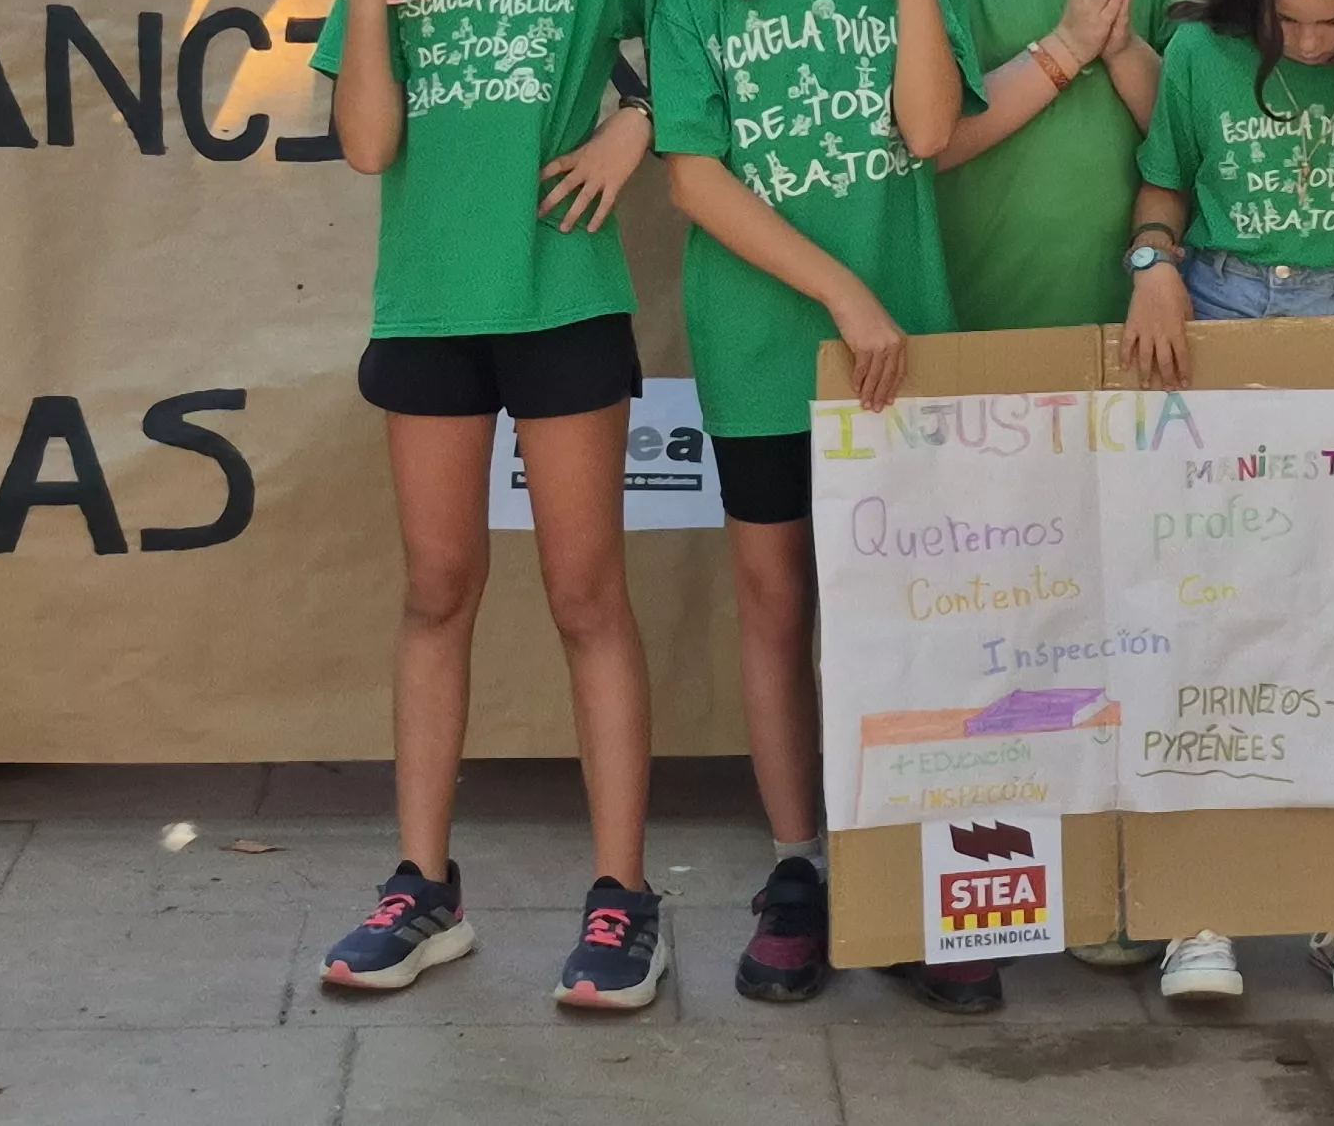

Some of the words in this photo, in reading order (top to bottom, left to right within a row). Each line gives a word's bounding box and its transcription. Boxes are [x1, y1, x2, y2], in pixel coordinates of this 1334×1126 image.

[417, 42, 448, 68] DE
[459, 35, 548, 62] TOD@S
[471, 77, 553, 103] TOD@S
[734, 105, 785, 149] DE
[1247, 169, 1280, 193] DE
[1236, 209, 1302, 235] PARA
[816, 390, 1205, 460] INJUSTICIA
[851, 495, 1065, 558] Queremos
[1152, 493, 1294, 562] profes
[907, 565, 1081, 622] Contentos
[1177, 574, 1239, 607] Con
[1144, 723, 1286, 764] PYRÉNÈES
[951, 873, 1037, 910] STEA
[939, 928, 1052, 951] INTERSINDICAL
